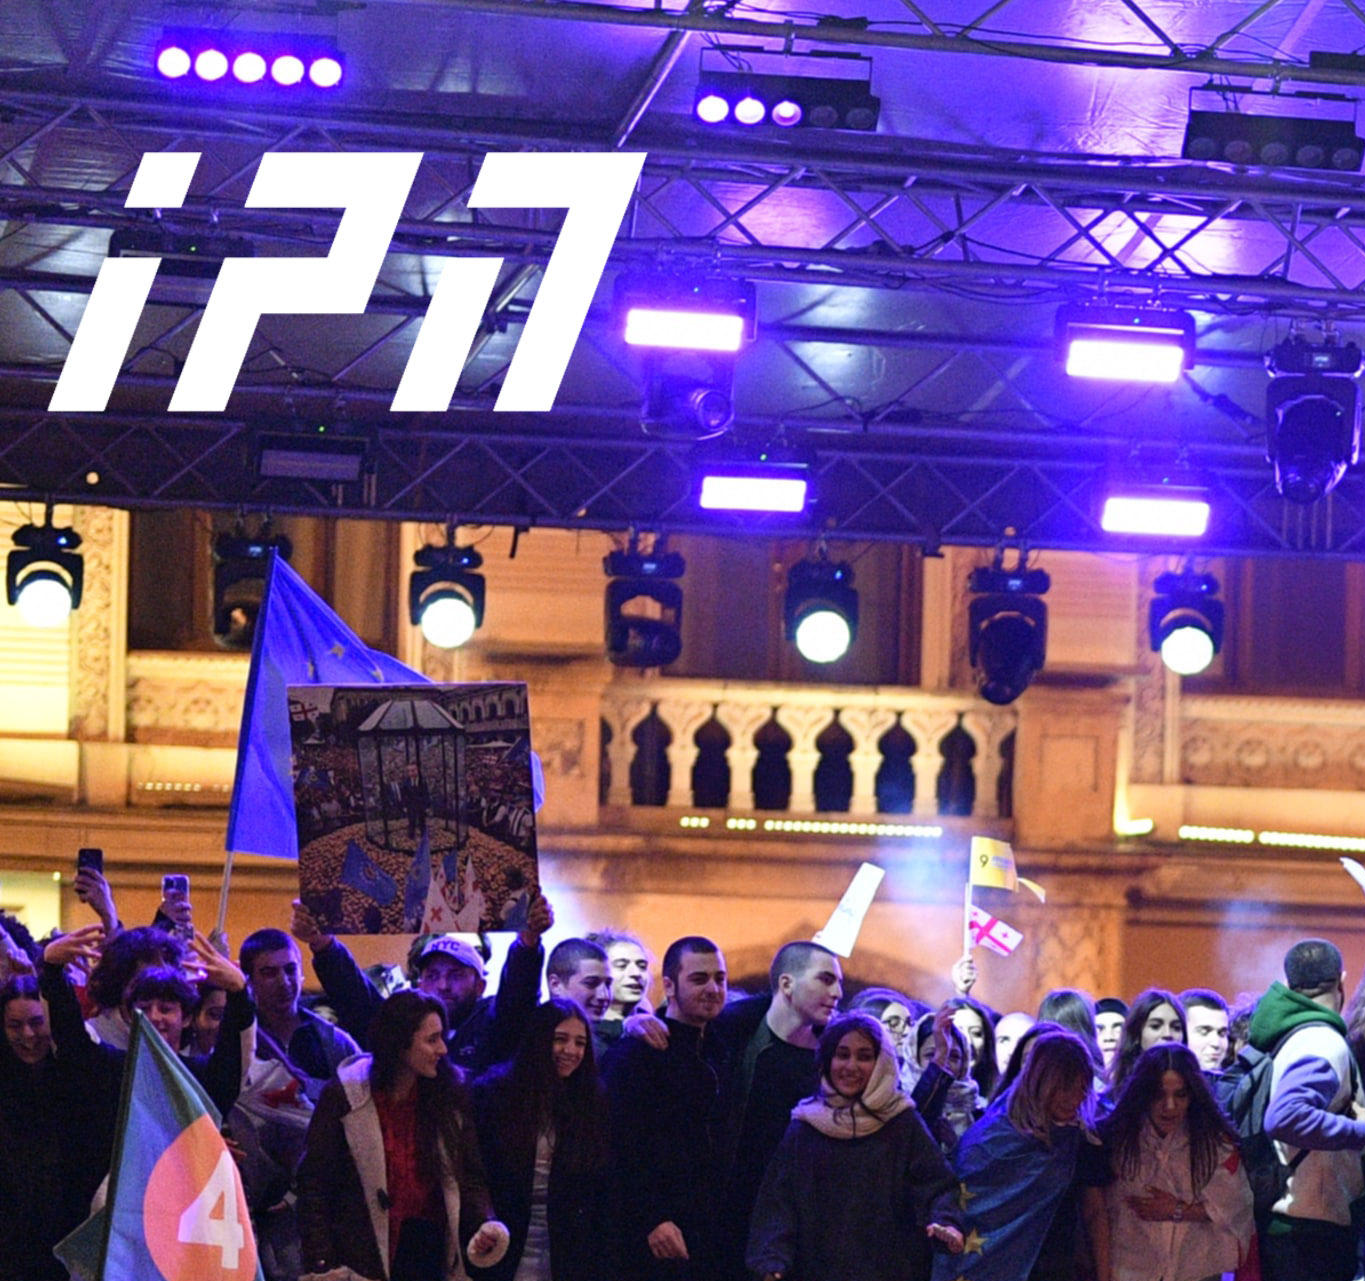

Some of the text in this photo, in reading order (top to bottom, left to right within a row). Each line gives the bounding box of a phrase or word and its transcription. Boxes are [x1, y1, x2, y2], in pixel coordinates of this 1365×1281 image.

[979, 854, 989, 868] 9
[432, 941, 460, 951] NYC
[177, 1149, 245, 1270] 4
